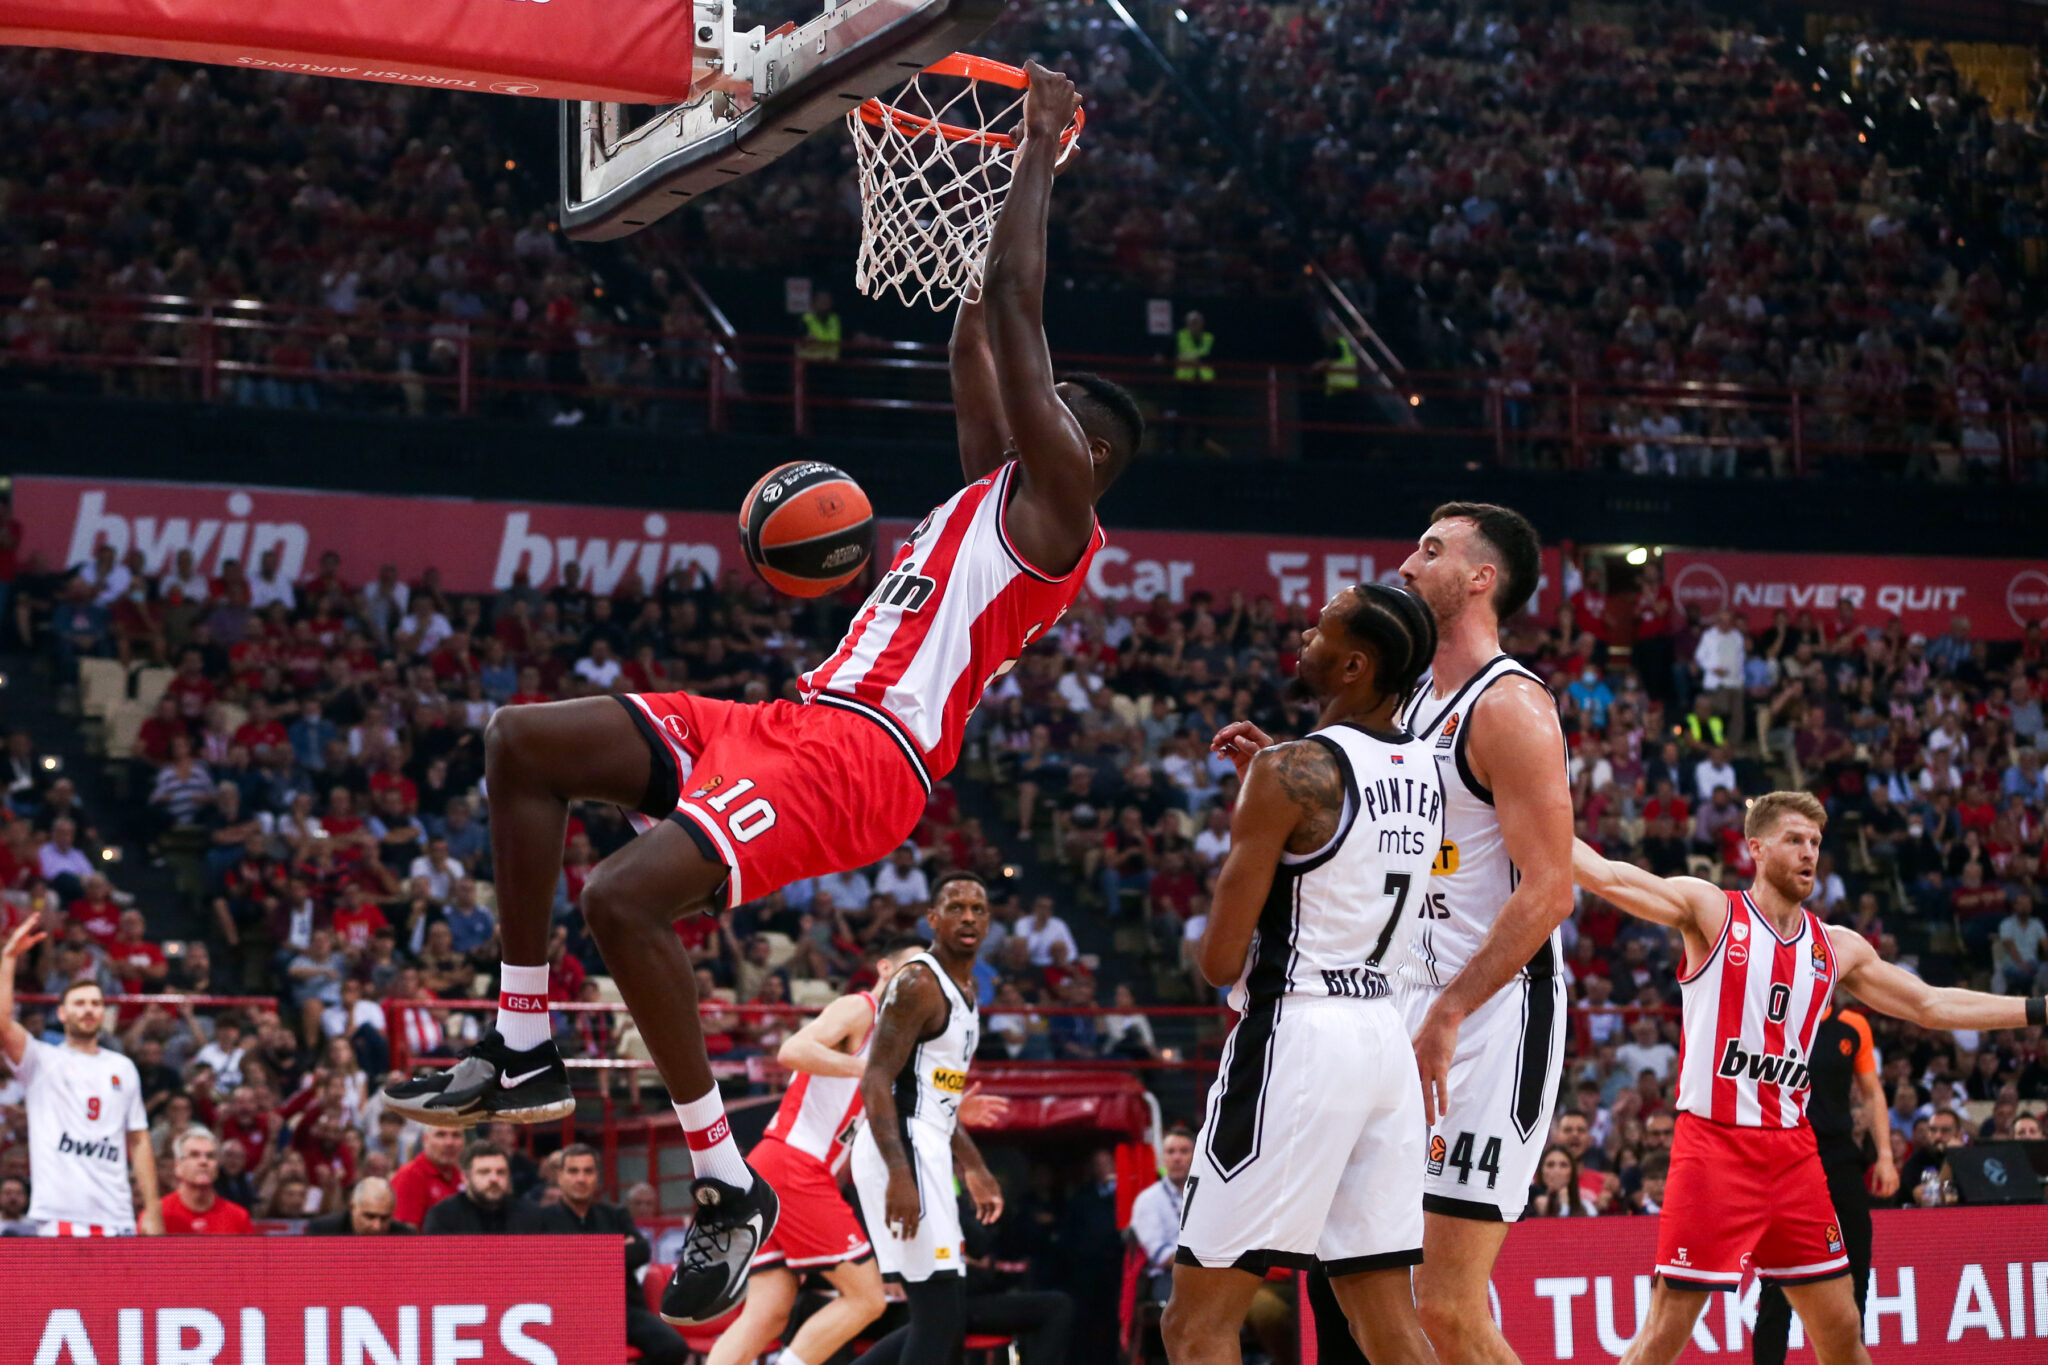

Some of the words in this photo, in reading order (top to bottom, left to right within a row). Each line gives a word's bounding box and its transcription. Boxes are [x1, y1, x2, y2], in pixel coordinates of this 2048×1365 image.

[236, 56, 358, 74] AIRLINES
[363, 70, 478, 88] TURKISH
[66, 490, 310, 580] bwin
[492, 511, 722, 596] bwin
[1732, 582, 1867, 609] NEVER
[1876, 584, 1967, 617] QUIT
[706, 778, 777, 843] 10
[1365, 778, 1440, 826] PUNTER
[1378, 824, 1424, 855] mts
[1365, 870, 1413, 968] 7
[507, 995, 543, 1011] GSA
[1768, 983, 1791, 1024] 0
[1718, 1038, 1810, 1090] bwin
[87, 1097, 102, 1121] 9
[59, 1131, 119, 1163] bwin
[1449, 1131, 1502, 1190] 44
[1180, 1175, 1200, 1231] 7
